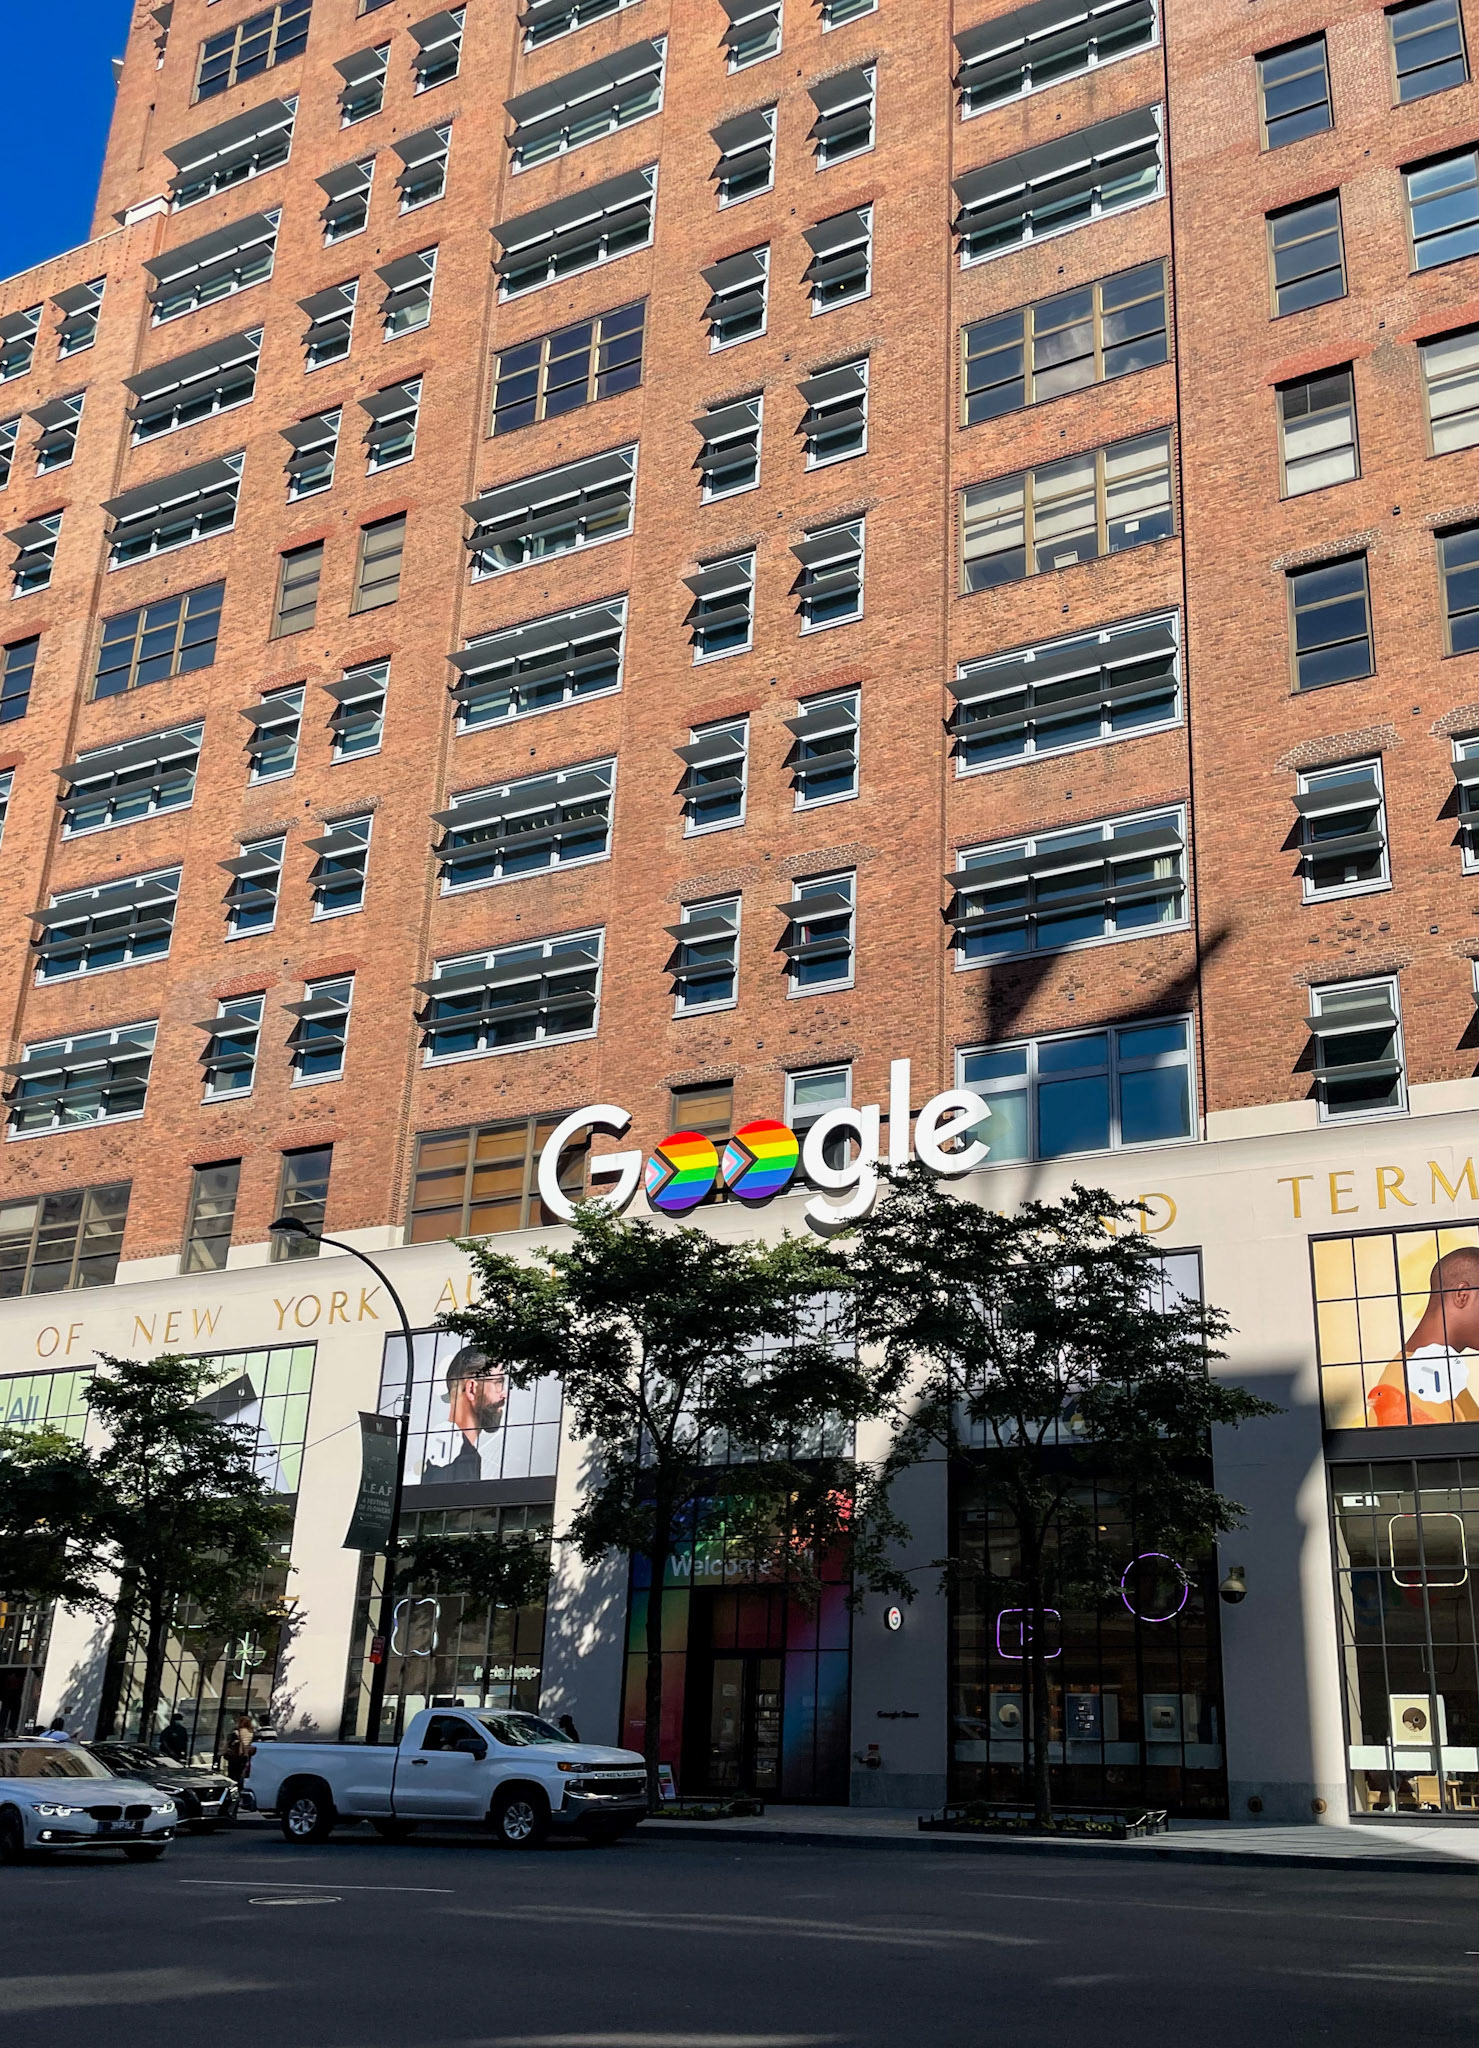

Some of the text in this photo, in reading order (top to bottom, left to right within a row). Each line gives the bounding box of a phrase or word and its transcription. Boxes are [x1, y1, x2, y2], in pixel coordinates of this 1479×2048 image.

[538, 1058, 993, 1225] Google
[1277, 1156, 1479, 1219] TERM
[35, 1285, 381, 1358] OF NEW YORK
[5, 1395, 40, 1427] All
